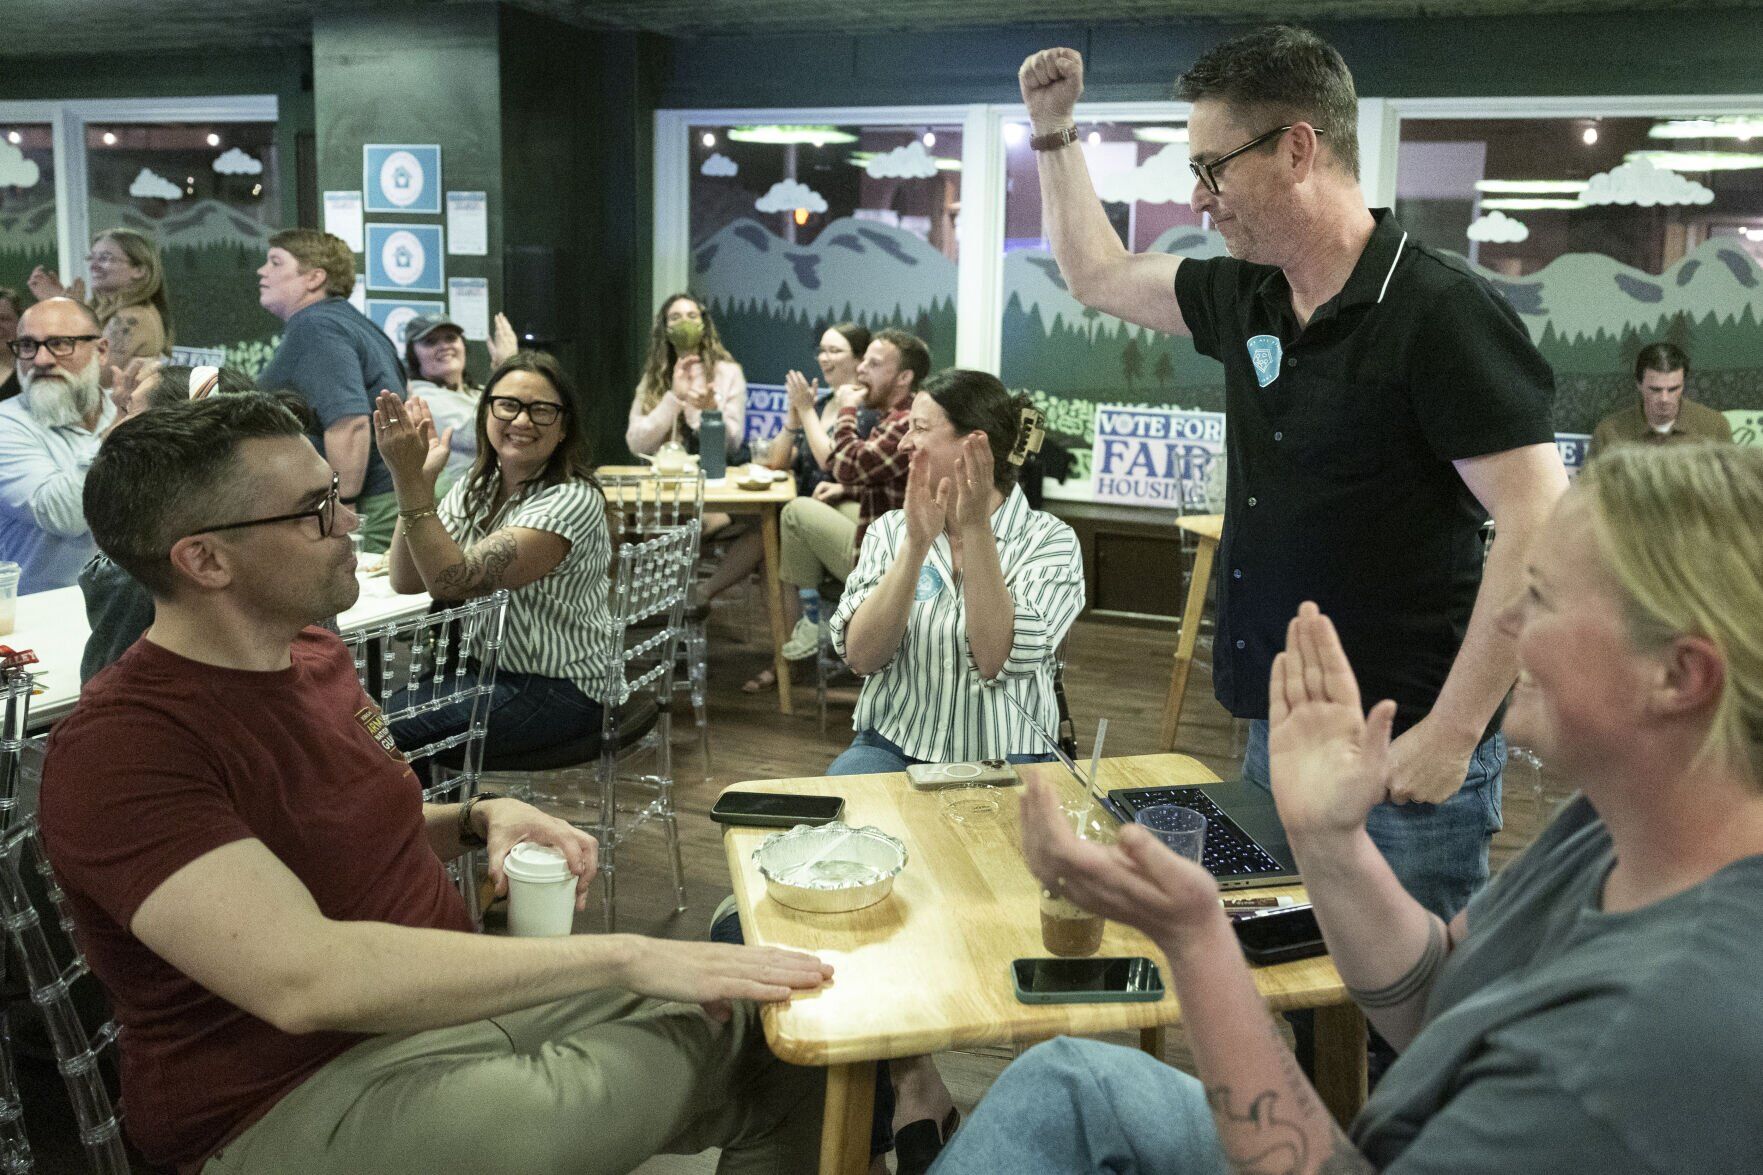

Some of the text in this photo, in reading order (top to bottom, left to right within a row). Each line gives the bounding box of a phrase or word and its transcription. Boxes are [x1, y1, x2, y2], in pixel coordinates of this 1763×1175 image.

[743, 414, 783, 443] FA
[1100, 413, 1221, 441] VOTE FOR
[1100, 439, 1211, 480] FAIR
